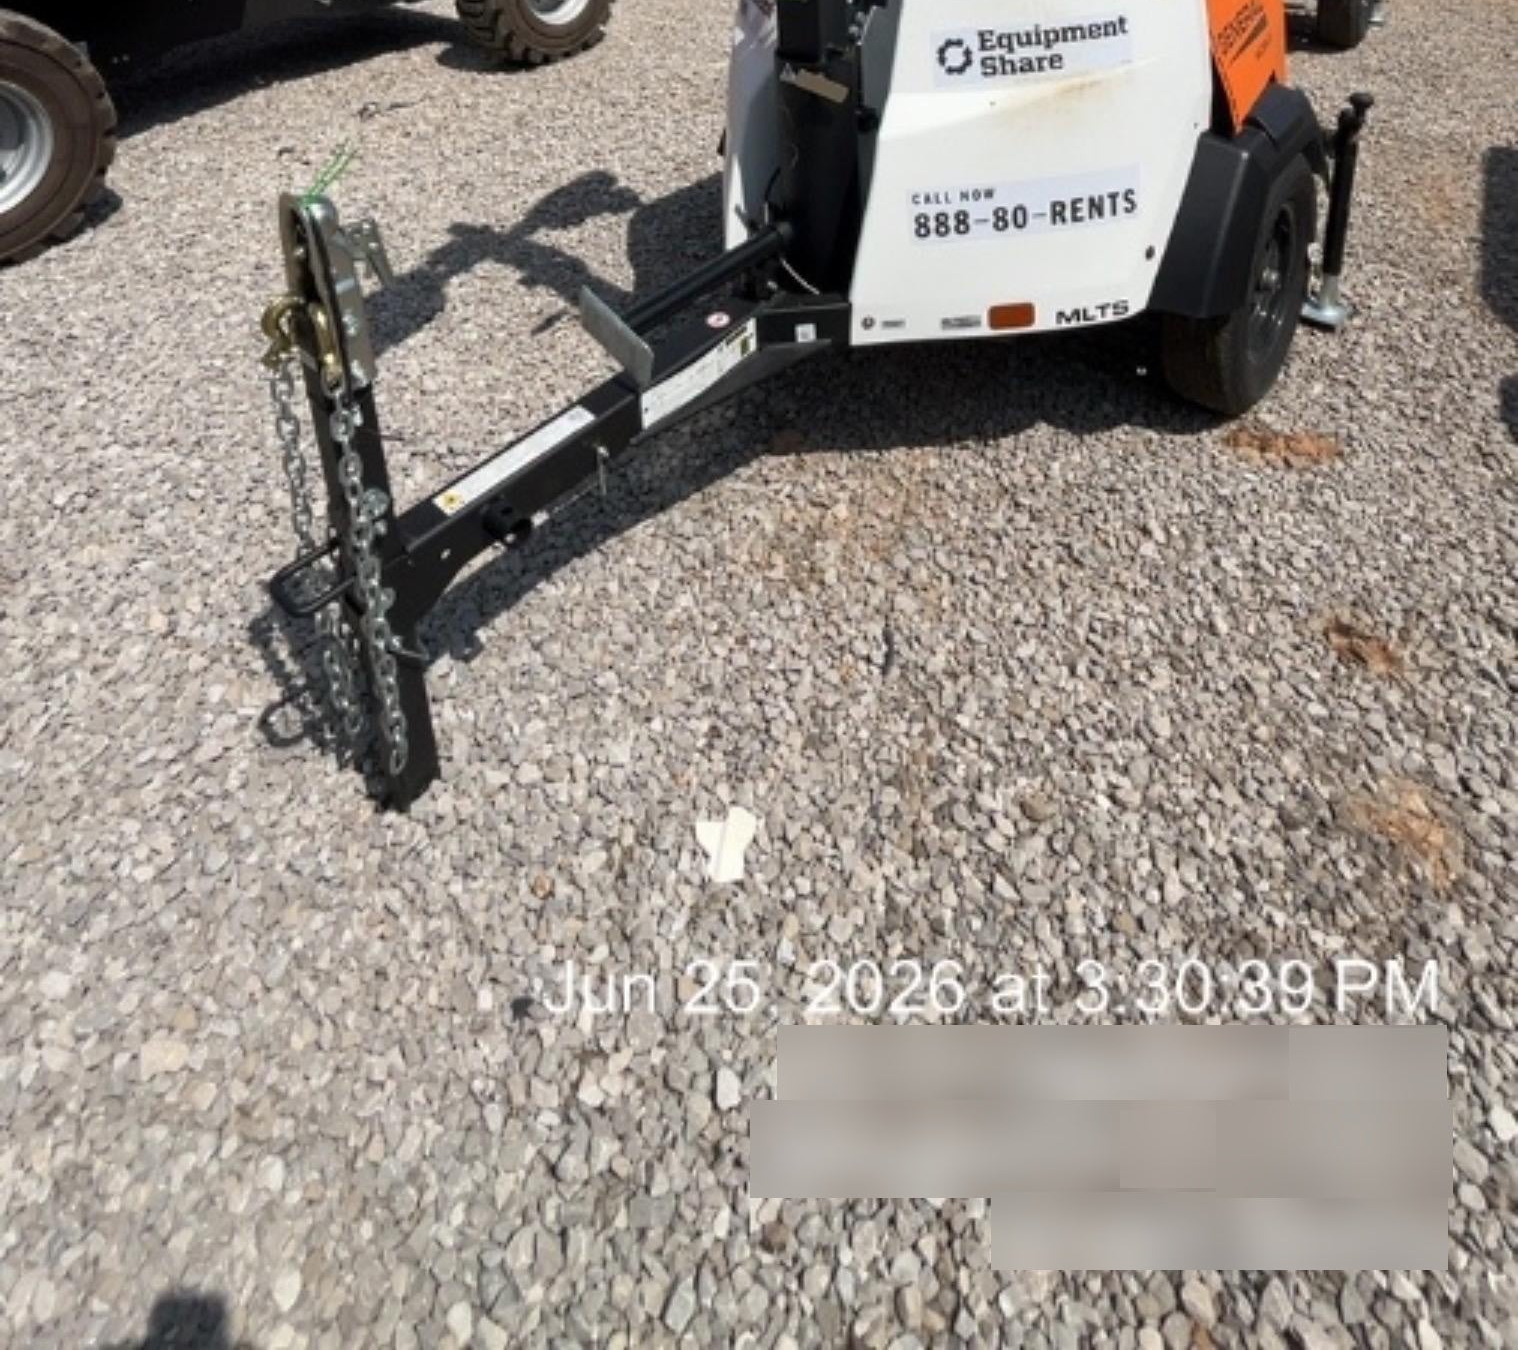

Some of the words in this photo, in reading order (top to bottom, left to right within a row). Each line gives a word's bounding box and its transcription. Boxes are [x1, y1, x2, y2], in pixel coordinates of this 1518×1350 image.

[977, 14, 1129, 53] Equipment
[980, 53, 1064, 78] Share
[911, 191, 952, 205] CALL
[959, 187, 996, 202] NOW
[914, 188, 1138, 239] 888-80-RENTS
[1055, 299, 1130, 325] MLTS
